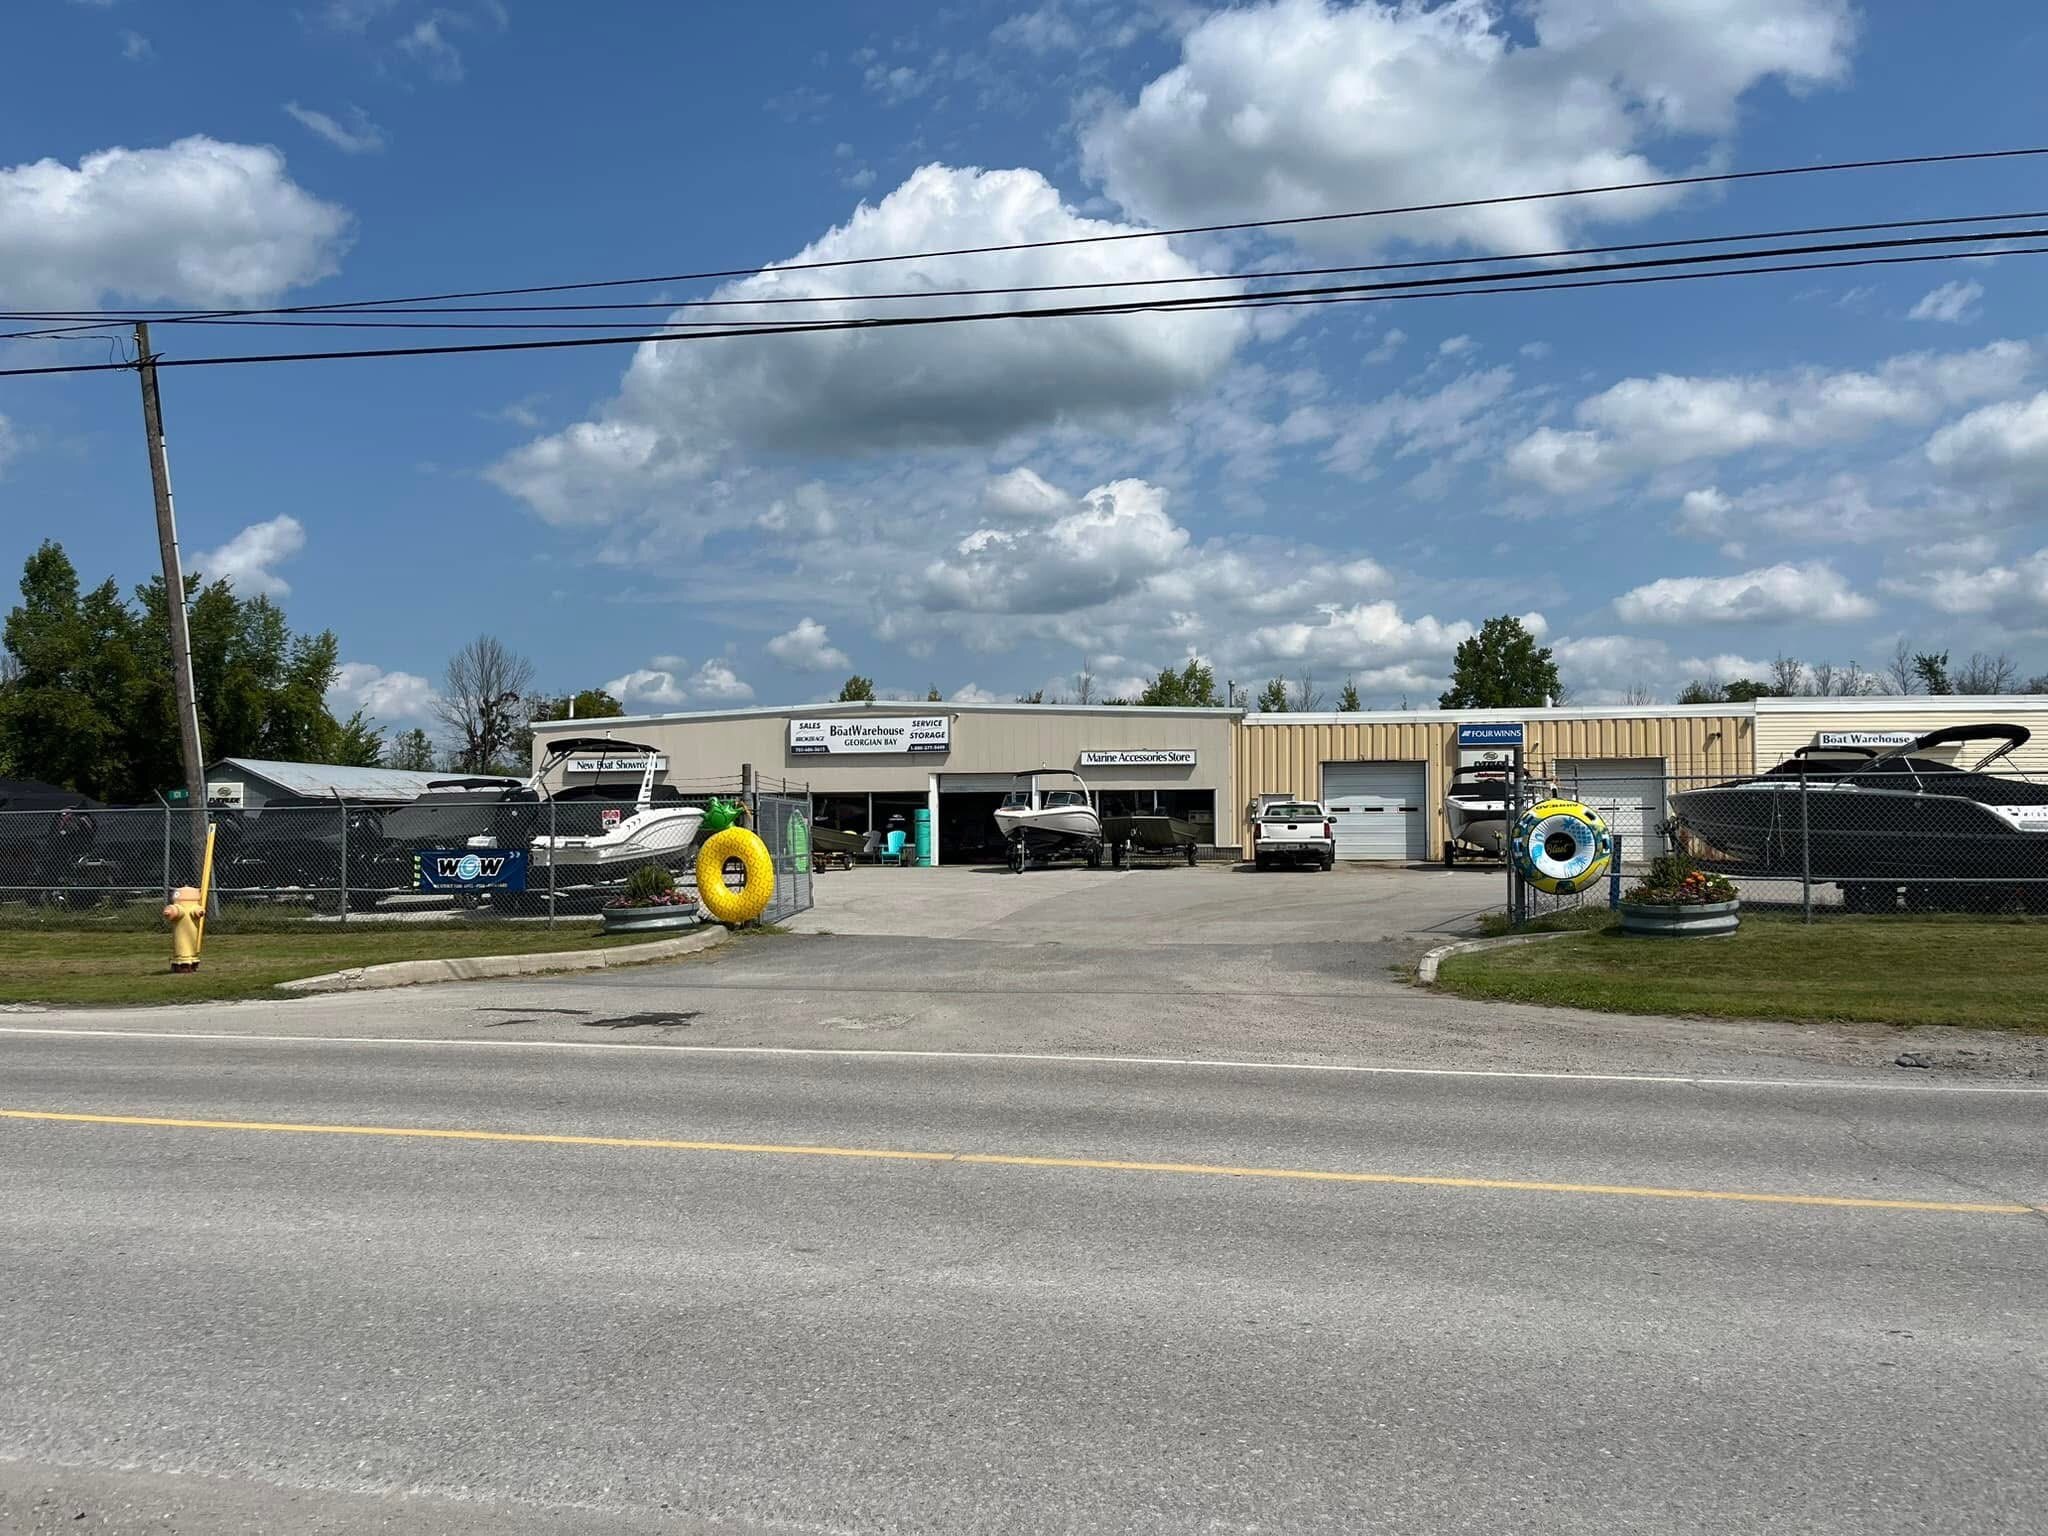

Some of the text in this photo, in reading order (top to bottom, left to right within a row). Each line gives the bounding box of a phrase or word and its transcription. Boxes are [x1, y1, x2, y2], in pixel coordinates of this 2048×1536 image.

[799, 722, 821, 730] SALES
[912, 719, 943, 727] SERVICE
[909, 731, 945, 739] STORAGE
[1822, 734, 1910, 744] Boat Warehouse
[844, 738, 898, 746] GEORGIAN BAY
[1087, 751, 1190, 762] Marine Accessories Store
[576, 761, 594, 769] New
[616, 760, 657, 769] Showro
[437, 854, 504, 880] WOW
